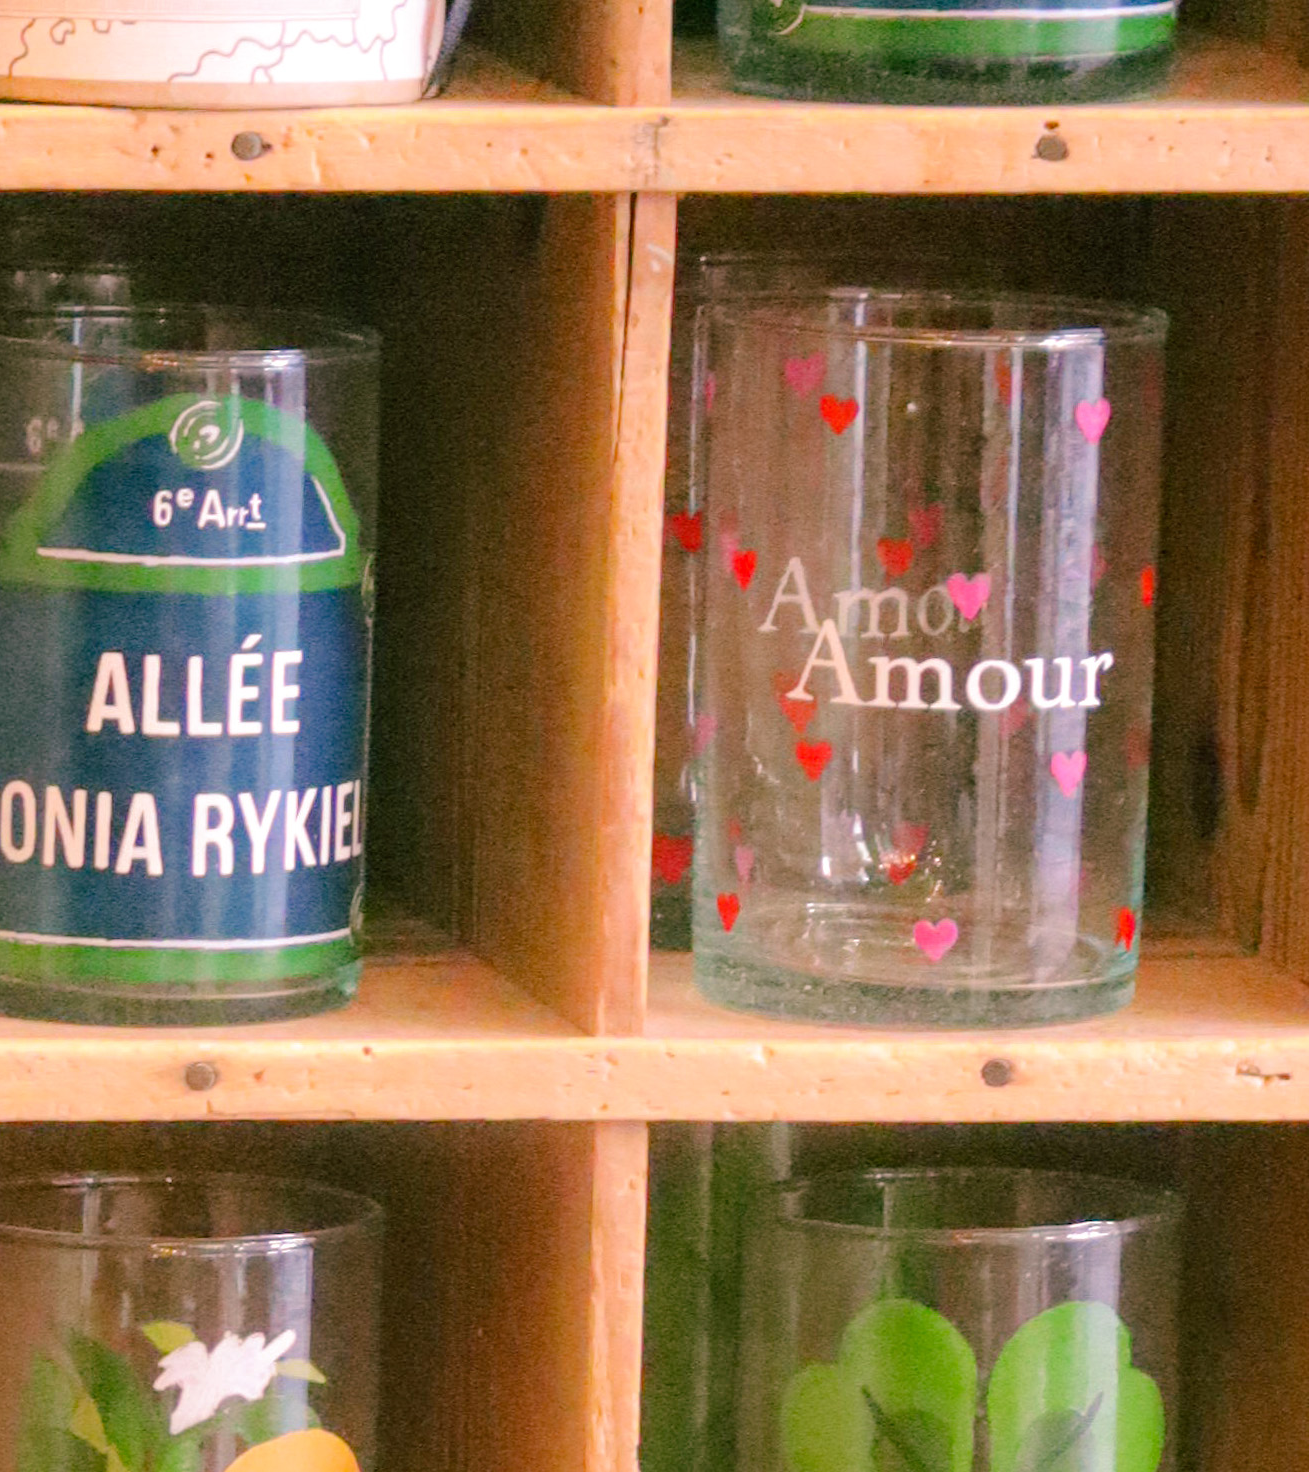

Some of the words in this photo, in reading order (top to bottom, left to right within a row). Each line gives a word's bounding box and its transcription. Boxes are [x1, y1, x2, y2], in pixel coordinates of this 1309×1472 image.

[152, 487, 195, 528] 6e
[197, 488, 267, 530] Arrt
[758, 556, 987, 638] Amo
[85, 634, 304, 737] ALLÉE
[785, 617, 1115, 712] Amour
[191, 779, 362, 877] RYKIEL
